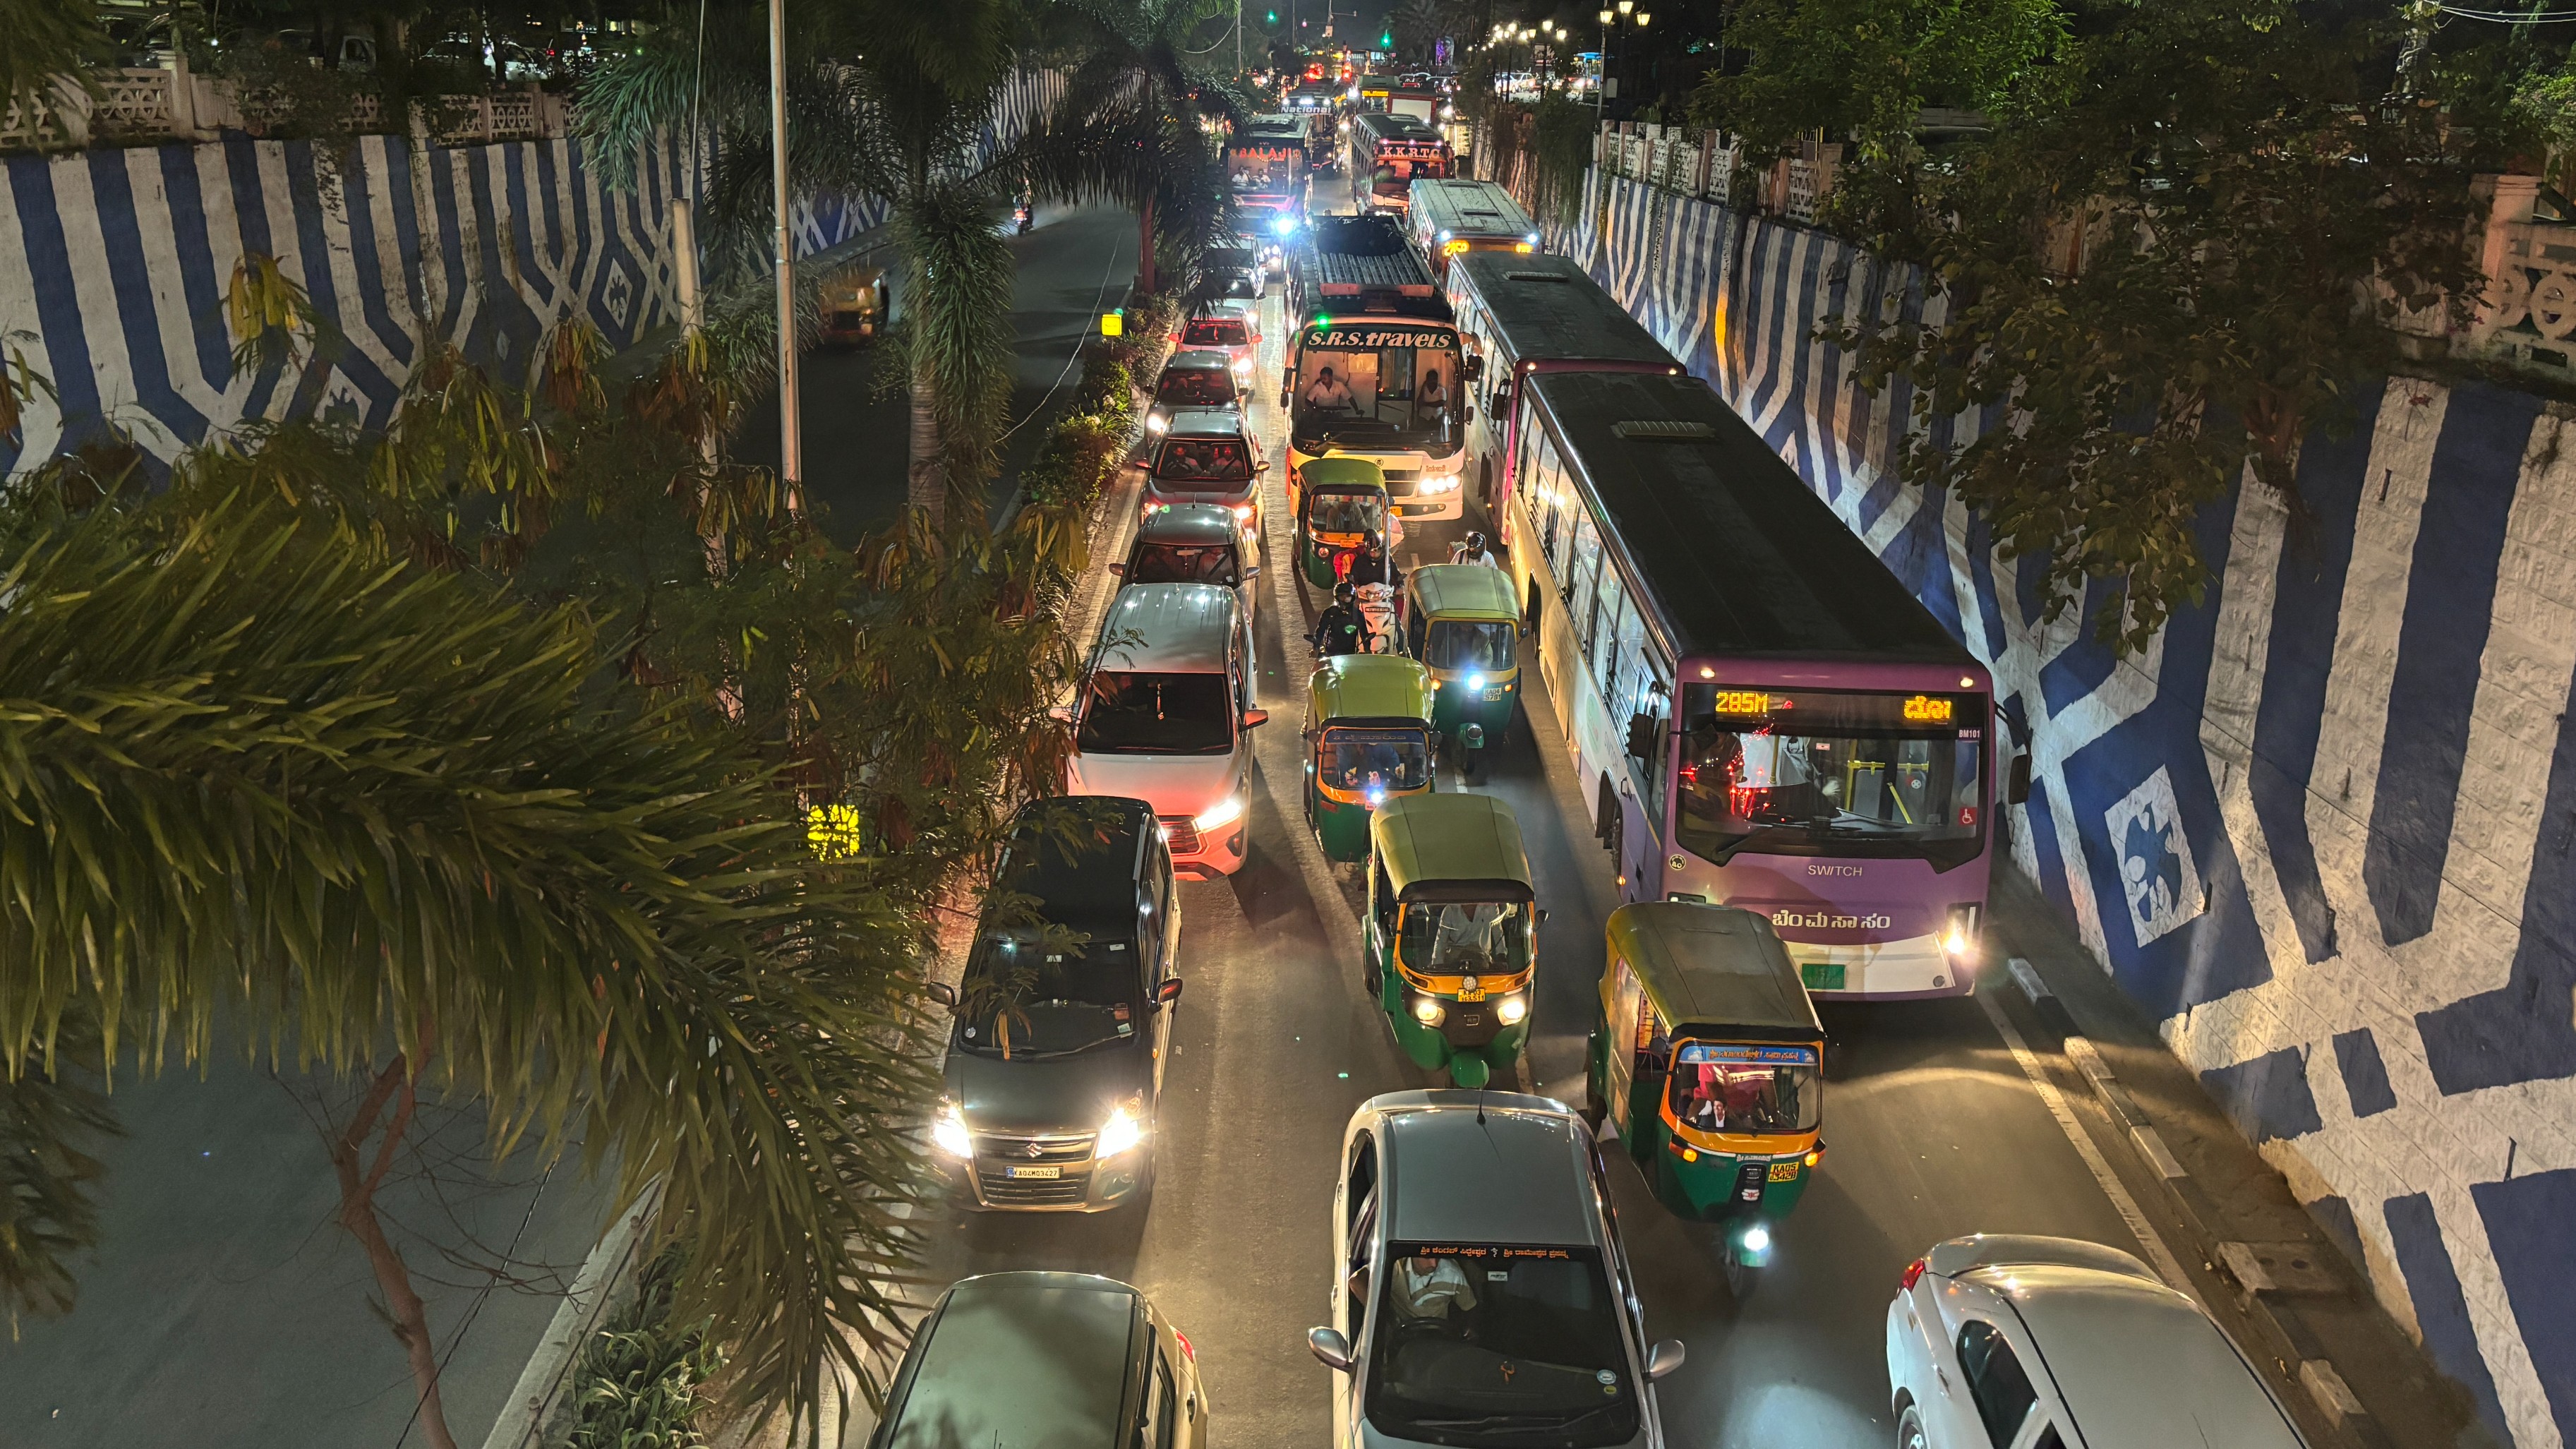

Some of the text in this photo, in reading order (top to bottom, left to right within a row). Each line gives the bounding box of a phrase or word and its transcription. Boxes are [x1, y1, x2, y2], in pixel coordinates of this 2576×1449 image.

[1715, 692, 1768, 713] 285M
[1958, 729, 1980, 738] BM101
[1807, 865, 1862, 877] SWITCH
[1774, 1163, 1797, 1173] KA05
